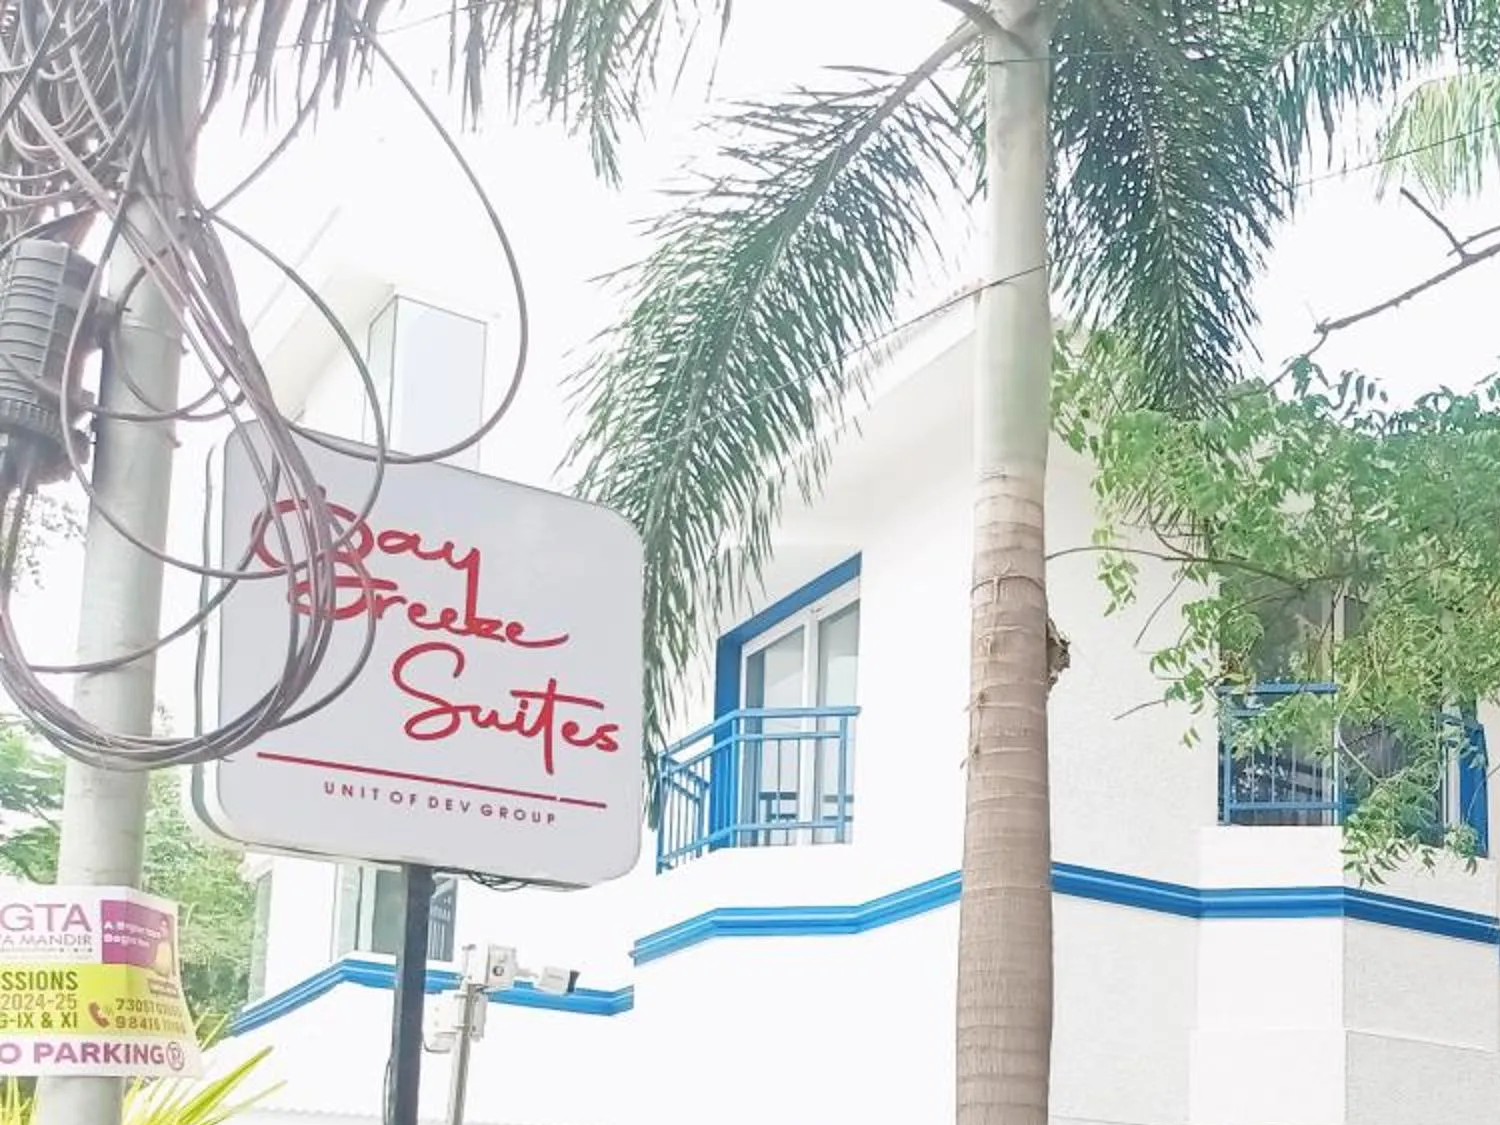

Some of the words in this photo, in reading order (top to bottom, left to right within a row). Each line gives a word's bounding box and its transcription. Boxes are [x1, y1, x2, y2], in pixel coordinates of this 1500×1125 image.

[391, 641, 619, 775] Suites
[324, 781, 381, 801] UNIT
[389, 791, 418, 806] OF
[428, 796, 471, 813] DEV
[480, 803, 556, 825] GROUP
[20, 933, 92, 946] MANDIR
[1, 992, 78, 1011] 2024-25
[41, 1011, 53, 1029] &
[60, 1011, 78, 1029] XI
[33, 1041, 165, 1065] PARKING
